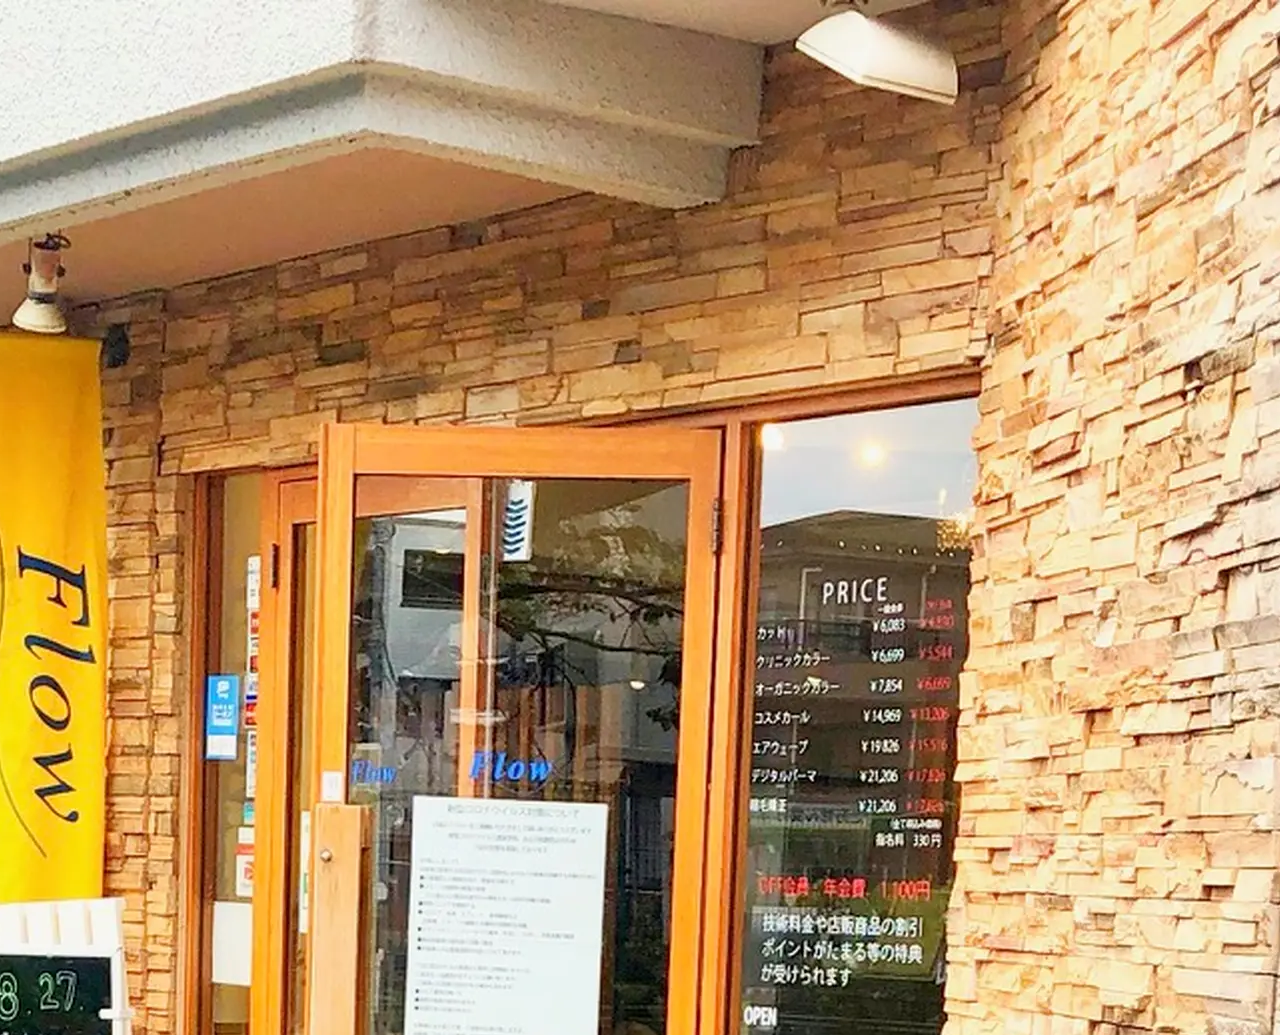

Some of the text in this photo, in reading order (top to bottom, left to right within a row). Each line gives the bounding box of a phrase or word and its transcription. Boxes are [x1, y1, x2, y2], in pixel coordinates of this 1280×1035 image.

[822, 577, 888, 604] PRICE
[756, 652, 830, 669] クリニックカラー
[16, 545, 96, 825] Flow
[755, 680, 840, 697] オーガニックカラー
[754, 711, 811, 725] コスメカール
[752, 740, 809, 756] エアウェーブ
[351, 759, 397, 784] Flow
[469, 751, 552, 782] Flow
[751, 768, 817, 783] デジタルパーマ
[761, 937, 923, 964] ポイントがたまる等の特典
[760, 963, 853, 987] が受けられます
[743, 1005, 778, 1026] OPEN
